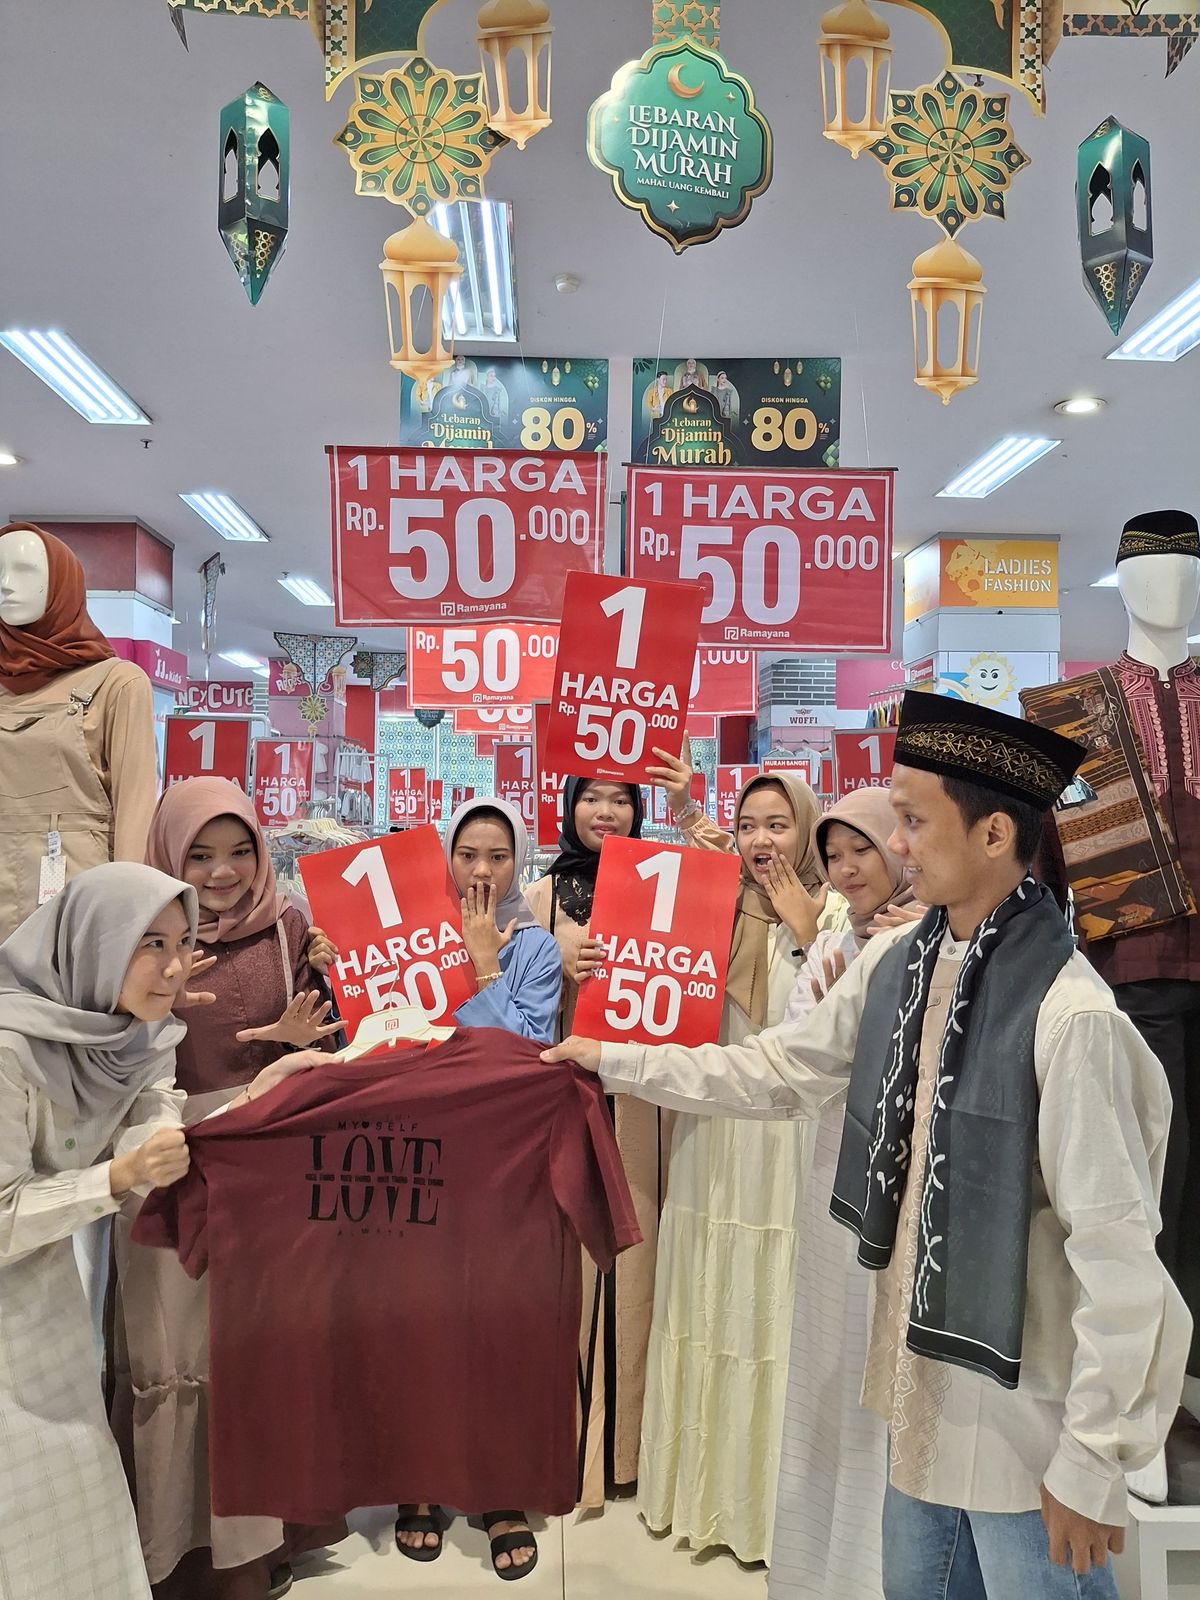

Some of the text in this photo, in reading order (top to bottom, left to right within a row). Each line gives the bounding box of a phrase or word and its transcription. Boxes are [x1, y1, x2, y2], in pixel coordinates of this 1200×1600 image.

[628, 105, 740, 140] LEBARAN
[626, 127, 738, 160] DIJAMIN
[633, 149, 732, 187] MURAH
[637, 178, 729, 198] MAHAL UANG KEMBALI
[431, 423, 491, 441] Dijamin
[442, 413, 481, 425] Lebaran
[672, 417, 711, 428] Lebaran
[661, 428, 722, 444] Dijamin
[652, 442, 731, 465] Murah
[347, 455, 587, 495] 1 HARGA
[644, 482, 876, 521] 1 HARGA
[345, 502, 384, 536] Rp.
[639, 527, 675, 561] Rp.
[984, 558, 1052, 575] LADIES
[984, 578, 1052, 592] FASHION
[456, 602, 507, 615] Ramayana
[599, 585, 647, 670] 1
[740, 628, 790, 639] Ramayana
[415, 628, 559, 693] Rp. 50.00
[482, 693, 514, 702] Ramayana
[560, 671, 680, 711] HARGA
[558, 701, 577, 716] Rp.
[789, 716, 818, 725] WOFFI
[188, 721, 216, 770] 1
[274, 743, 290, 775] 1
[858, 735, 881, 774] 1
[514, 746, 531, 778] 1
[260, 776, 306, 787] HARGA
[399, 769, 411, 788] 1
[729, 768, 742, 790] 1
[341, 845, 403, 929] 1
[635, 850, 682, 933] 1
[335, 921, 464, 981] HARGA
[594, 933, 718, 979] HARGA
[342, 984, 365, 998] Rp.
[307, 1134, 442, 1225] LOVE
